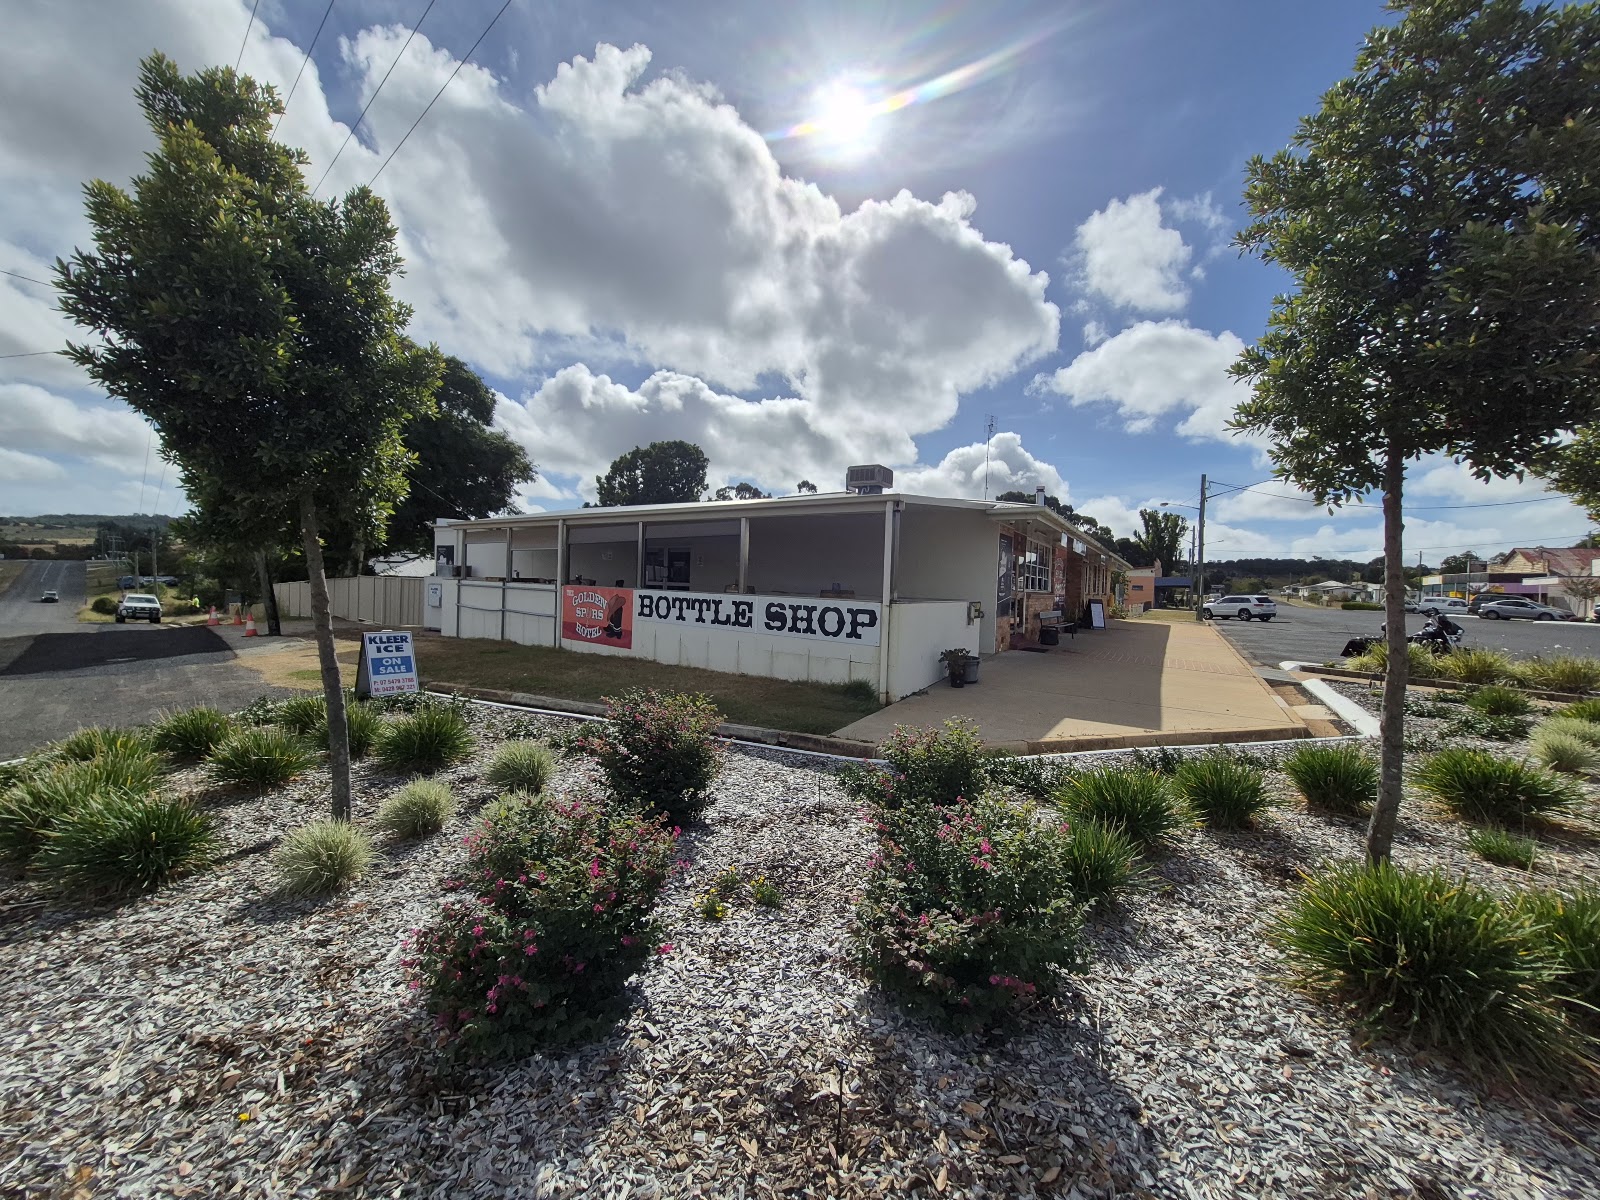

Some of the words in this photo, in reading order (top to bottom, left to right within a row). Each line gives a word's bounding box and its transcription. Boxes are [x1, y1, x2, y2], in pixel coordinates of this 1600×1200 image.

[572, 591, 608, 610] GOLDEN
[638, 595, 753, 628] BOTTLE
[764, 602, 878, 639] SHOP
[575, 622, 602, 638] HOTEL
[368, 635, 409, 645] KLEER
[376, 644, 405, 653] ICE
[379, 665, 406, 674] SALE
